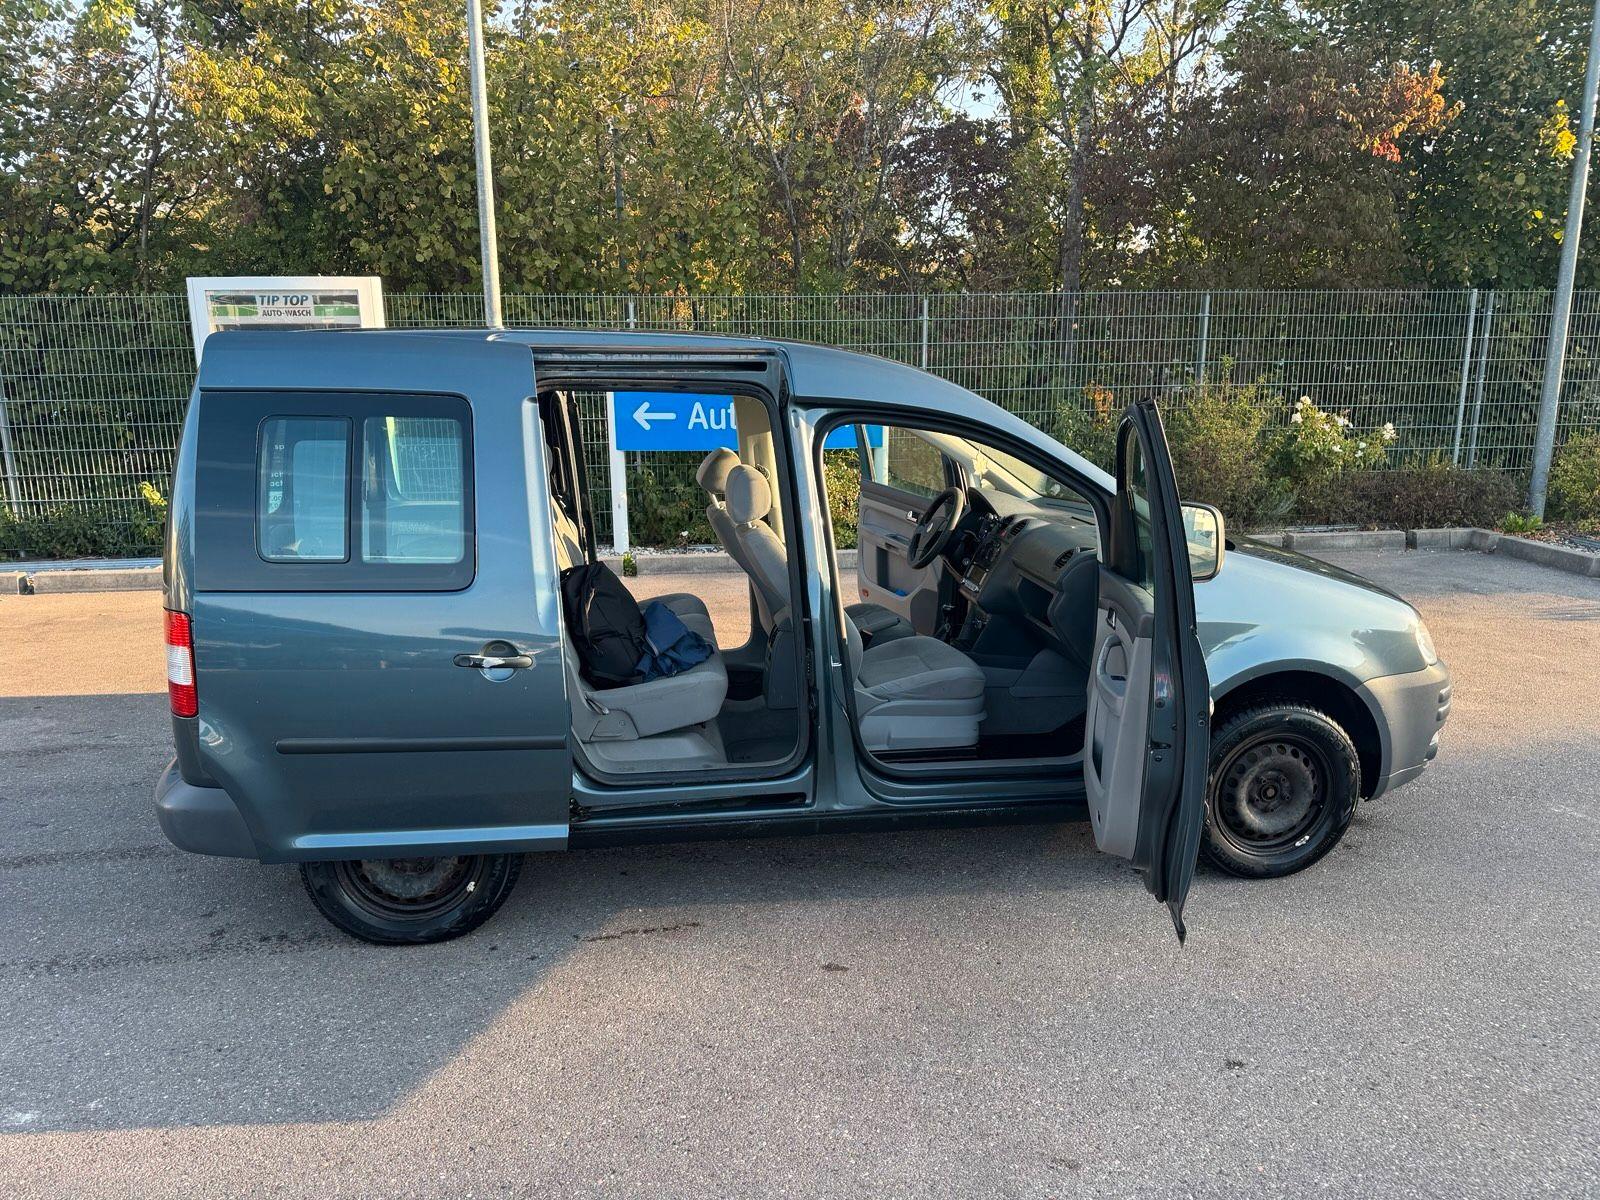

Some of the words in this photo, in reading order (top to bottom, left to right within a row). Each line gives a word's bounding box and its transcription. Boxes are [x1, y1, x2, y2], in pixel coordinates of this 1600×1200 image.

[259, 295, 280, 306] TIP
[282, 295, 309, 306] TOP
[262, 309, 312, 317] AUTO-WASCH
